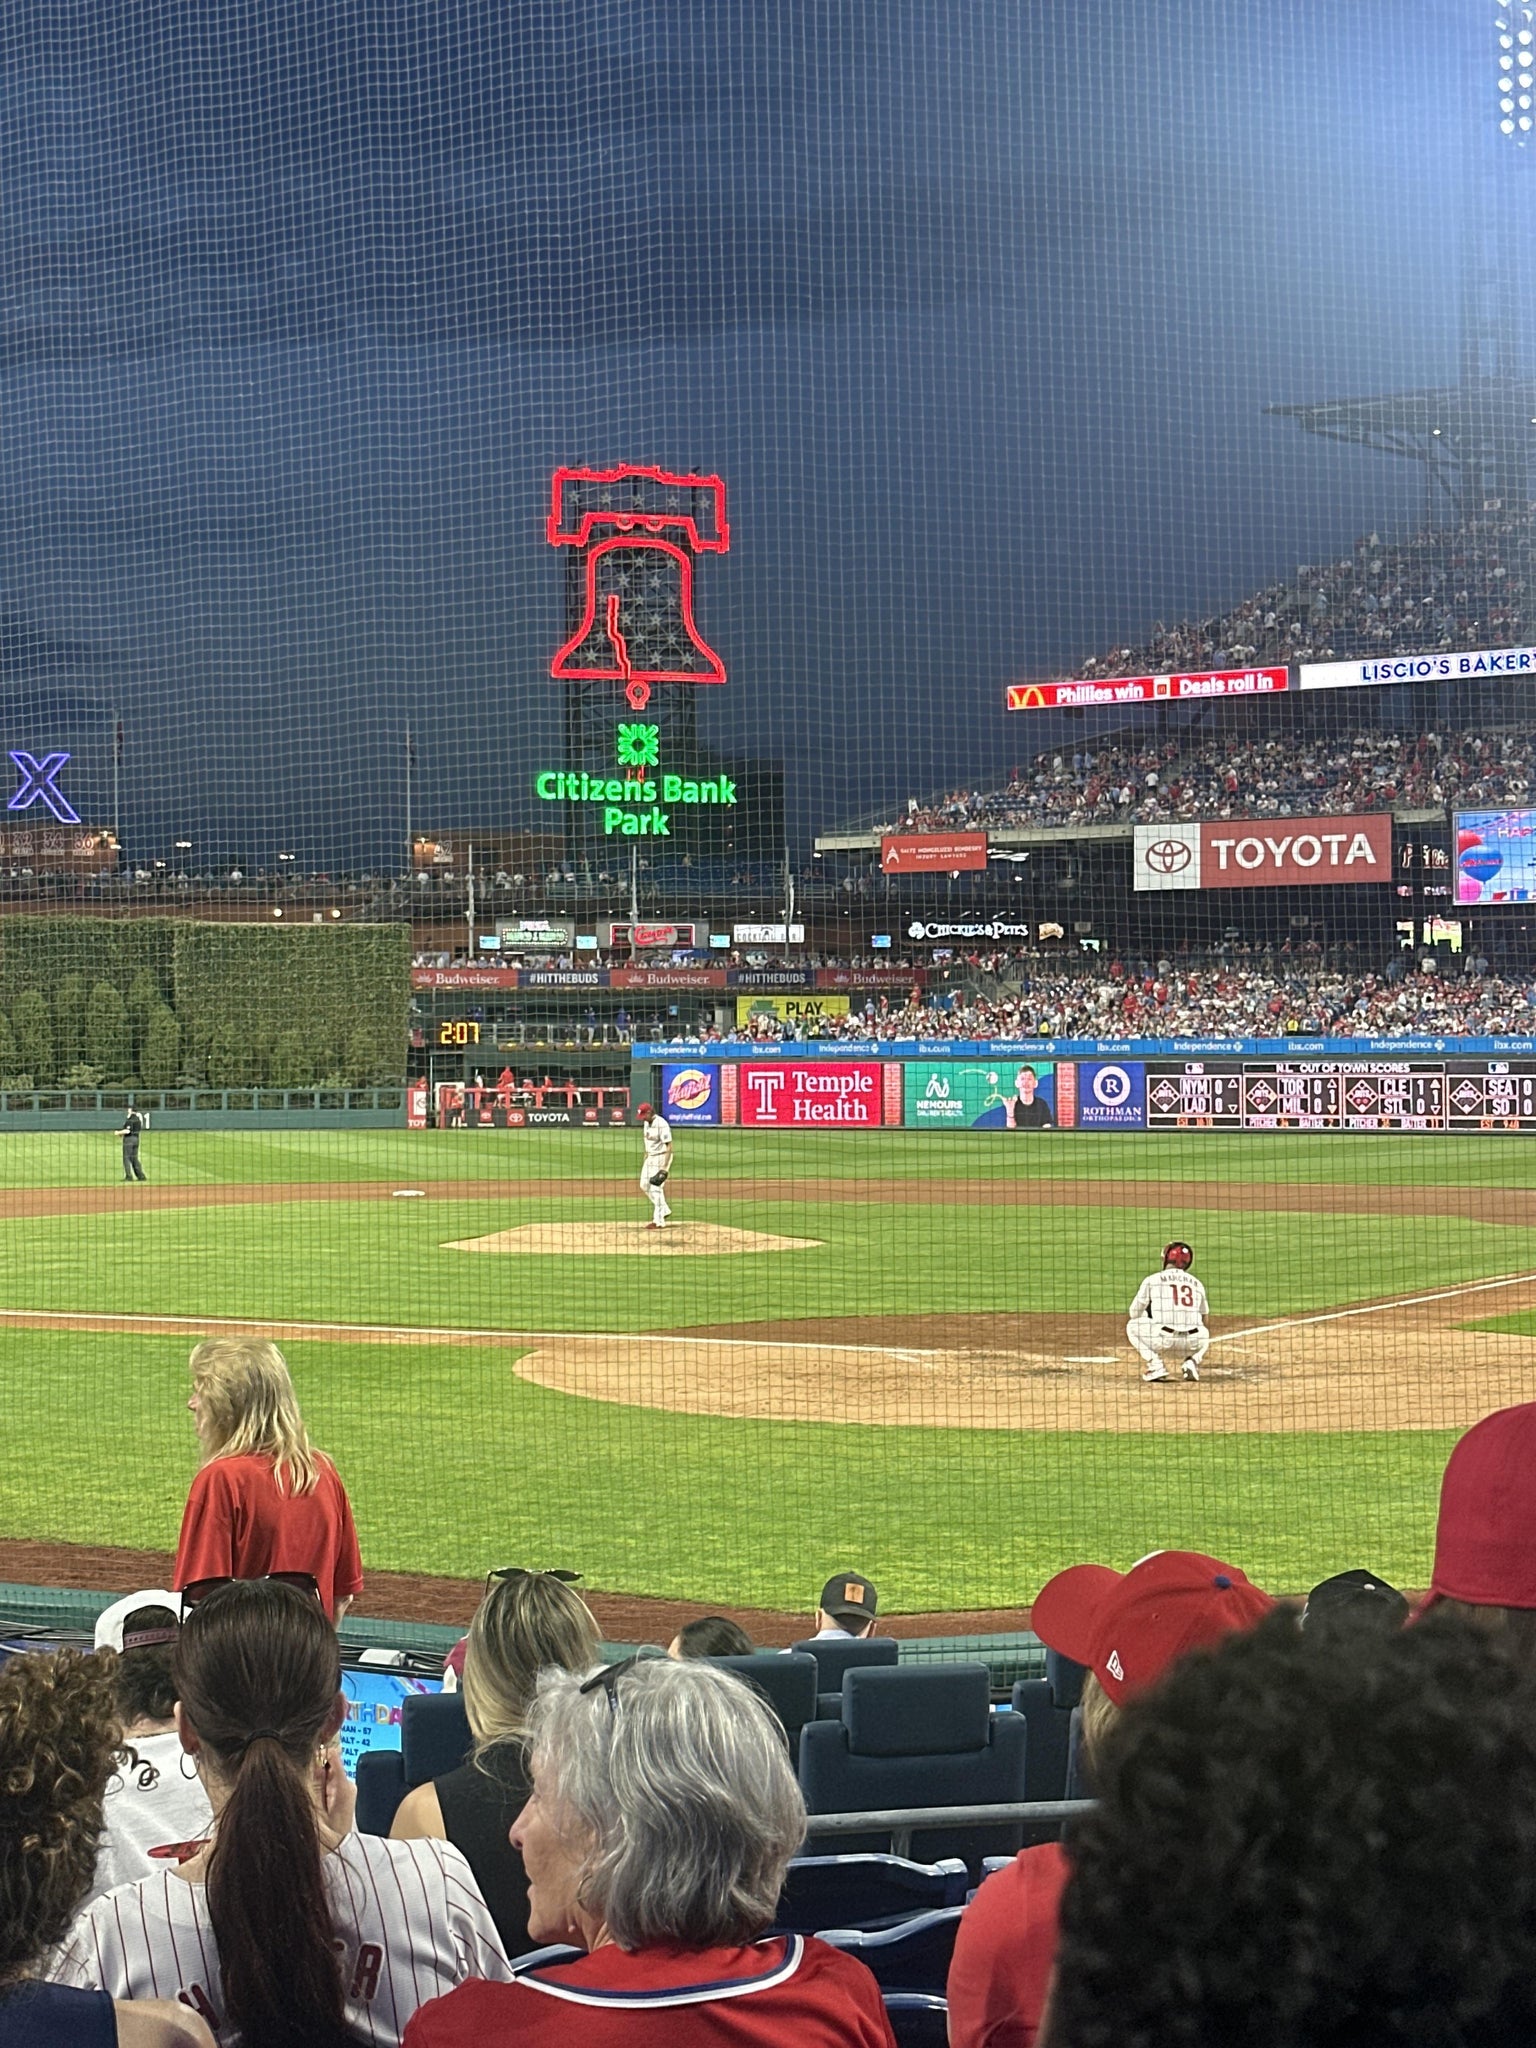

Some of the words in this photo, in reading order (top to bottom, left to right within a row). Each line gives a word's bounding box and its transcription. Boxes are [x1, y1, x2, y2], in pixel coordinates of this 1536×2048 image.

[1362, 660, 1450, 681] LISCIO'S
[1056, 685, 1112, 704] Phillies
[1114, 684, 1144, 700] win
[1179, 676, 1224, 695] Deals
[1227, 674, 1255, 690] roll
[1256, 673, 1274, 689] in
[8, 750, 81, 824] X
[536, 771, 657, 802] Citizens
[663, 775, 738, 804] Bank
[604, 806, 671, 835] Park
[1497, 827, 1536, 838] HAP
[1211, 833, 1377, 870] TOYOTA
[780, 933, 797, 944] BR
[436, 973, 497, 985] Budweiser
[529, 973, 599, 984] #HITTHEBUDS
[647, 973, 708, 985] Budweiser
[738, 973, 806, 984] #HITTHEBUDS
[786, 1002, 823, 1015] PLAY
[441, 1022, 480, 1044] 2:07
[991, 1043, 1045, 1053] Independence
[1097, 1043, 1130, 1052] ibx.com
[1174, 1042, 1231, 1052] Independence
[1288, 1042, 1324, 1050] ibx.com
[1370, 1040, 1432, 1050] Independence
[1494, 1040, 1532, 1050] ibx.com
[1300, 1063, 1320, 1073] OUT
[1321, 1063, 1337, 1073] OF
[1338, 1063, 1368, 1073] TOWN
[1370, 1063, 1411, 1073] SCORES
[792, 1071, 873, 1098] Temple
[1105, 1079, 1120, 1093] R
[1182, 1079, 1207, 1095] NYM
[1281, 1079, 1304, 1094] TOR
[1384, 1079, 1407, 1095] CLE
[1417, 1079, 1424, 1095] 1
[1489, 1079, 1513, 1095] SEA
[793, 1099, 869, 1120] Health
[1083, 1107, 1141, 1116] ROTHMAN
[1184, 1098, 1207, 1112] LAD
[1282, 1099, 1304, 1113] MIL
[1384, 1099, 1407, 1114] STL
[1492, 1099, 1510, 1114] SD
[528, 1113, 570, 1122] TOYOTA
[1249, 1118, 1277, 1127] PITCHER
[1349, 1118, 1378, 1128] PITCHER
[1169, 1284, 1194, 1307] 13
[341, 1736, 355, 1745] ALT
